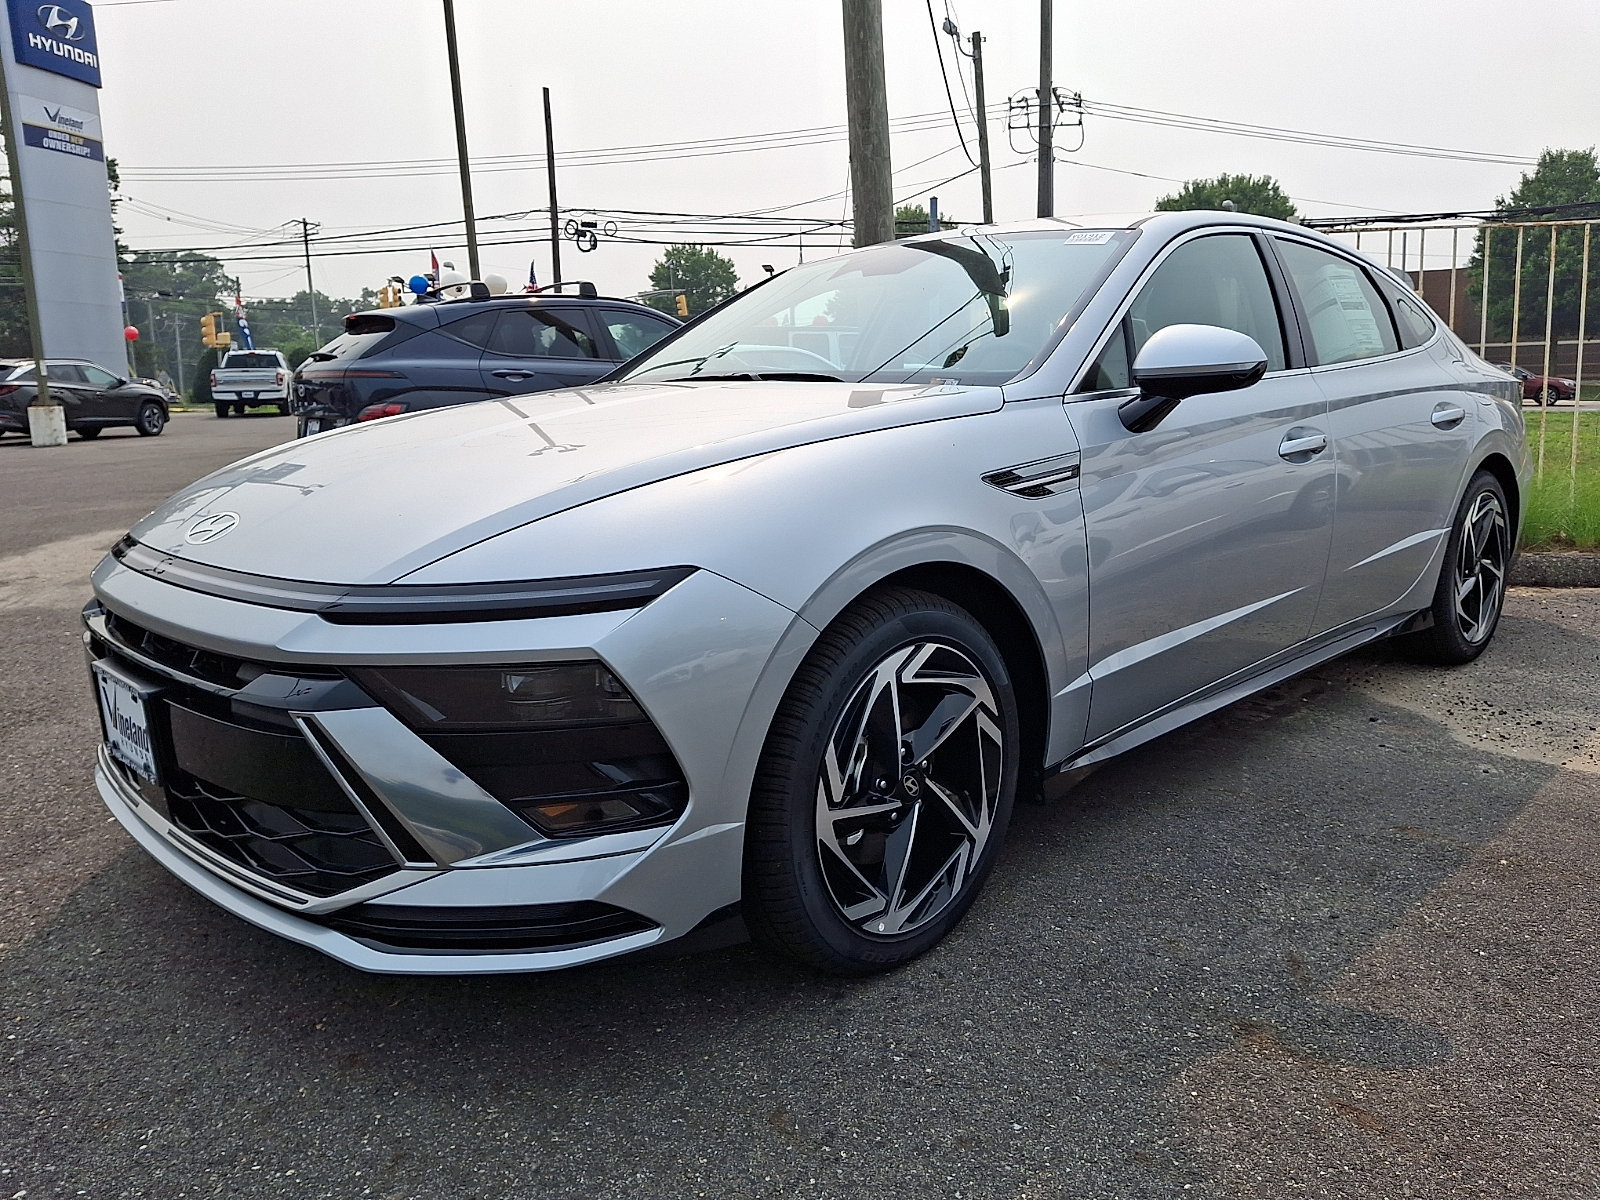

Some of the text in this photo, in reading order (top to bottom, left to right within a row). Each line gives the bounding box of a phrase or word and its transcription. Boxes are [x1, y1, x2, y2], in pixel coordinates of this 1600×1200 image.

[28, 32, 98, 69] HYUNDAI
[43, 106, 83, 129] Vineland
[43, 137, 91, 157] OWNERSHIP!
[48, 130, 70, 142] UNDER
[102, 685, 150, 753] Vineland
